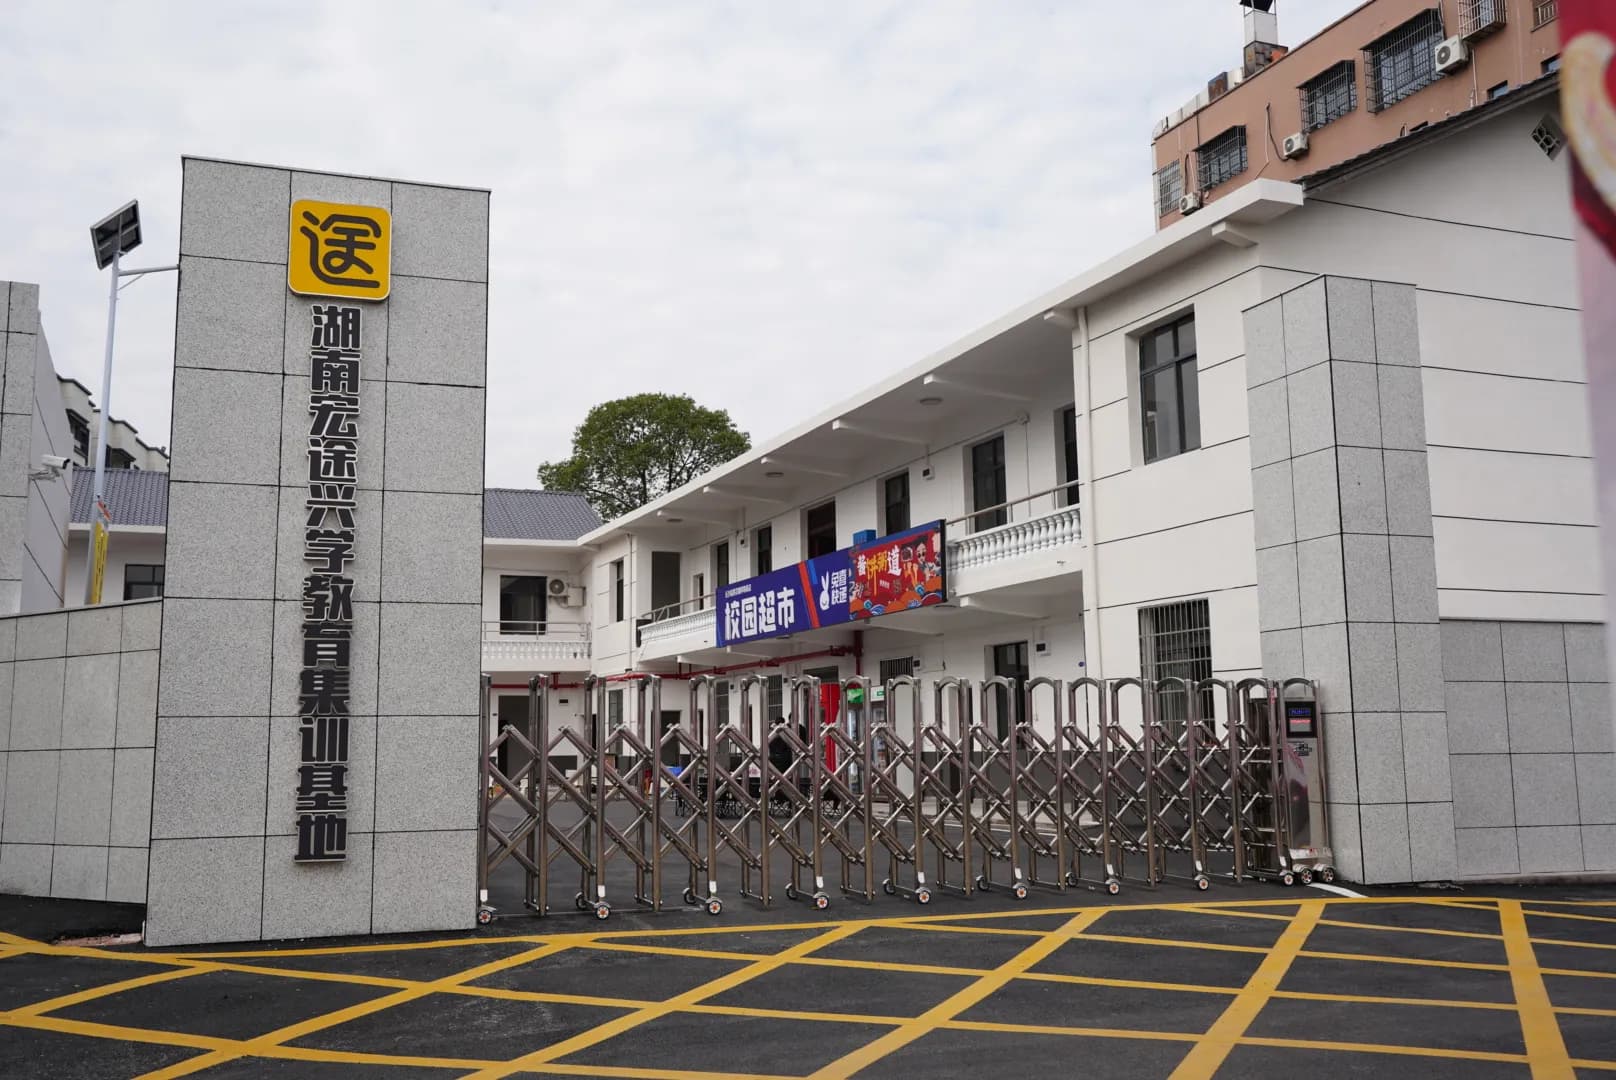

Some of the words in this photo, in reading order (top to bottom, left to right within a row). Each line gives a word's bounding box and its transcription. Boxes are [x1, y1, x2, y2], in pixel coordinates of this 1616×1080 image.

[294, 305, 361, 863] 湖南宏途兴学教育集训基地
[725, 587, 795, 641] 校园超市
